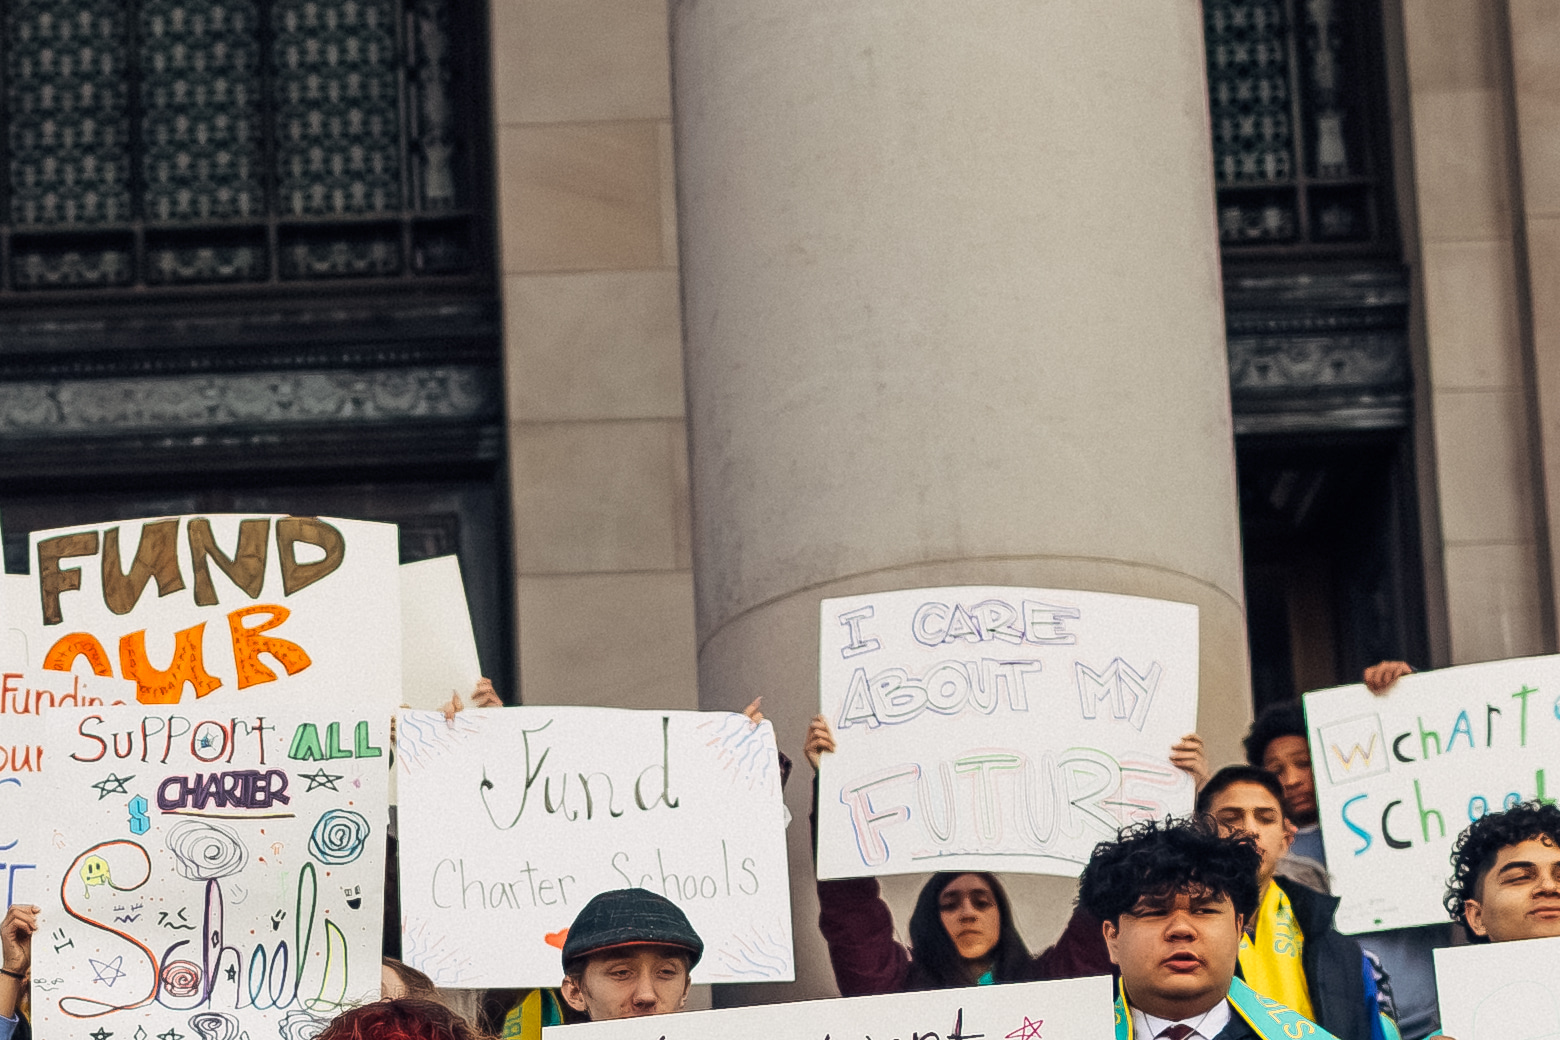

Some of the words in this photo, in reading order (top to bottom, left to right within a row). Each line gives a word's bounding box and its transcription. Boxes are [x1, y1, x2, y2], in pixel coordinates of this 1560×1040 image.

[37, 517, 346, 626] FUND
[838, 605, 881, 659] I
[912, 600, 1081, 646] CARE
[1, 673, 127, 716] Fundin
[838, 657, 1042, 730] ABOUT
[1075, 656, 1163, 732] MY
[287, 720, 383, 762] ALL
[156, 769, 292, 809] CHARTER
[479, 716, 679, 830] Fund
[839, 746, 1190, 867] FUTURE
[431, 858, 576, 909] Charter
